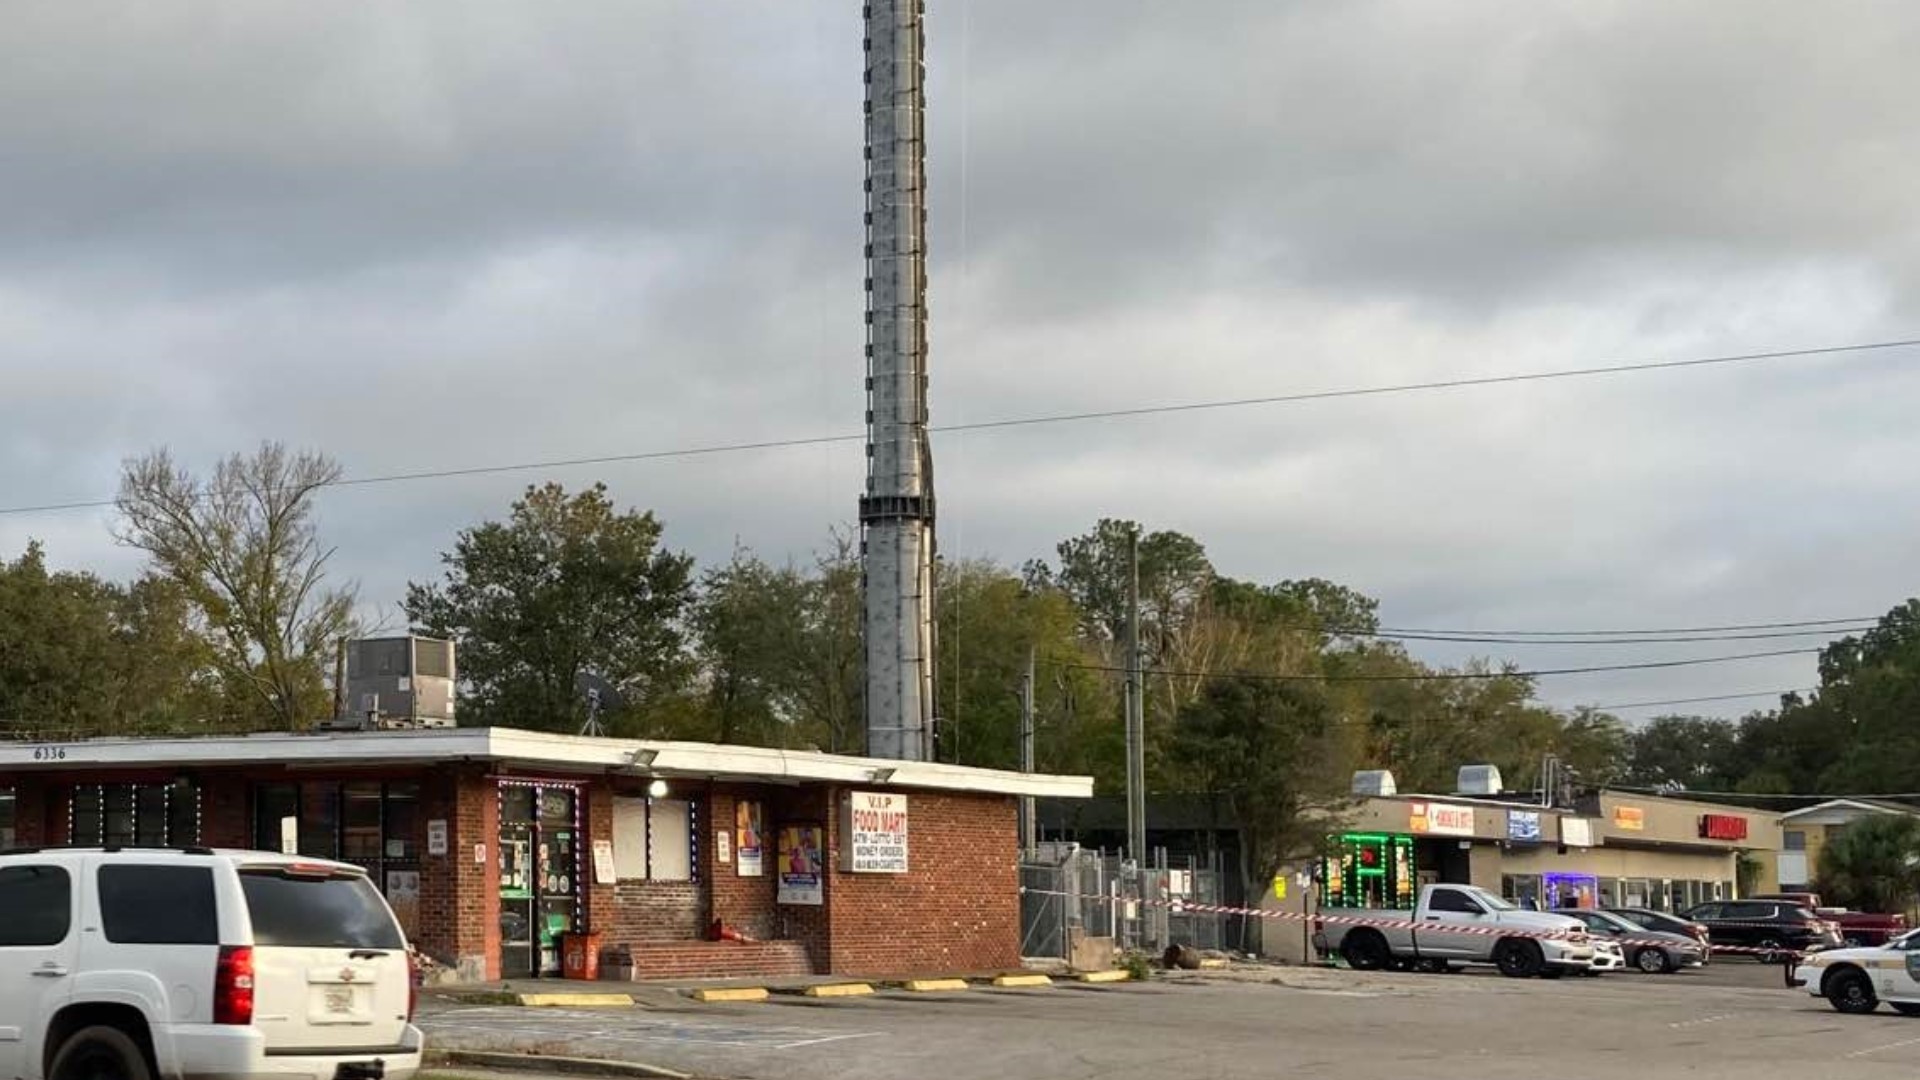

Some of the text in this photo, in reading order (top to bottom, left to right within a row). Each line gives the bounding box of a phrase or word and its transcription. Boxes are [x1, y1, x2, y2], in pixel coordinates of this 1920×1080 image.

[34, 746, 66, 759] 6336
[854, 809, 905, 833] FOOD MART
[856, 846, 878, 856] MONEY
